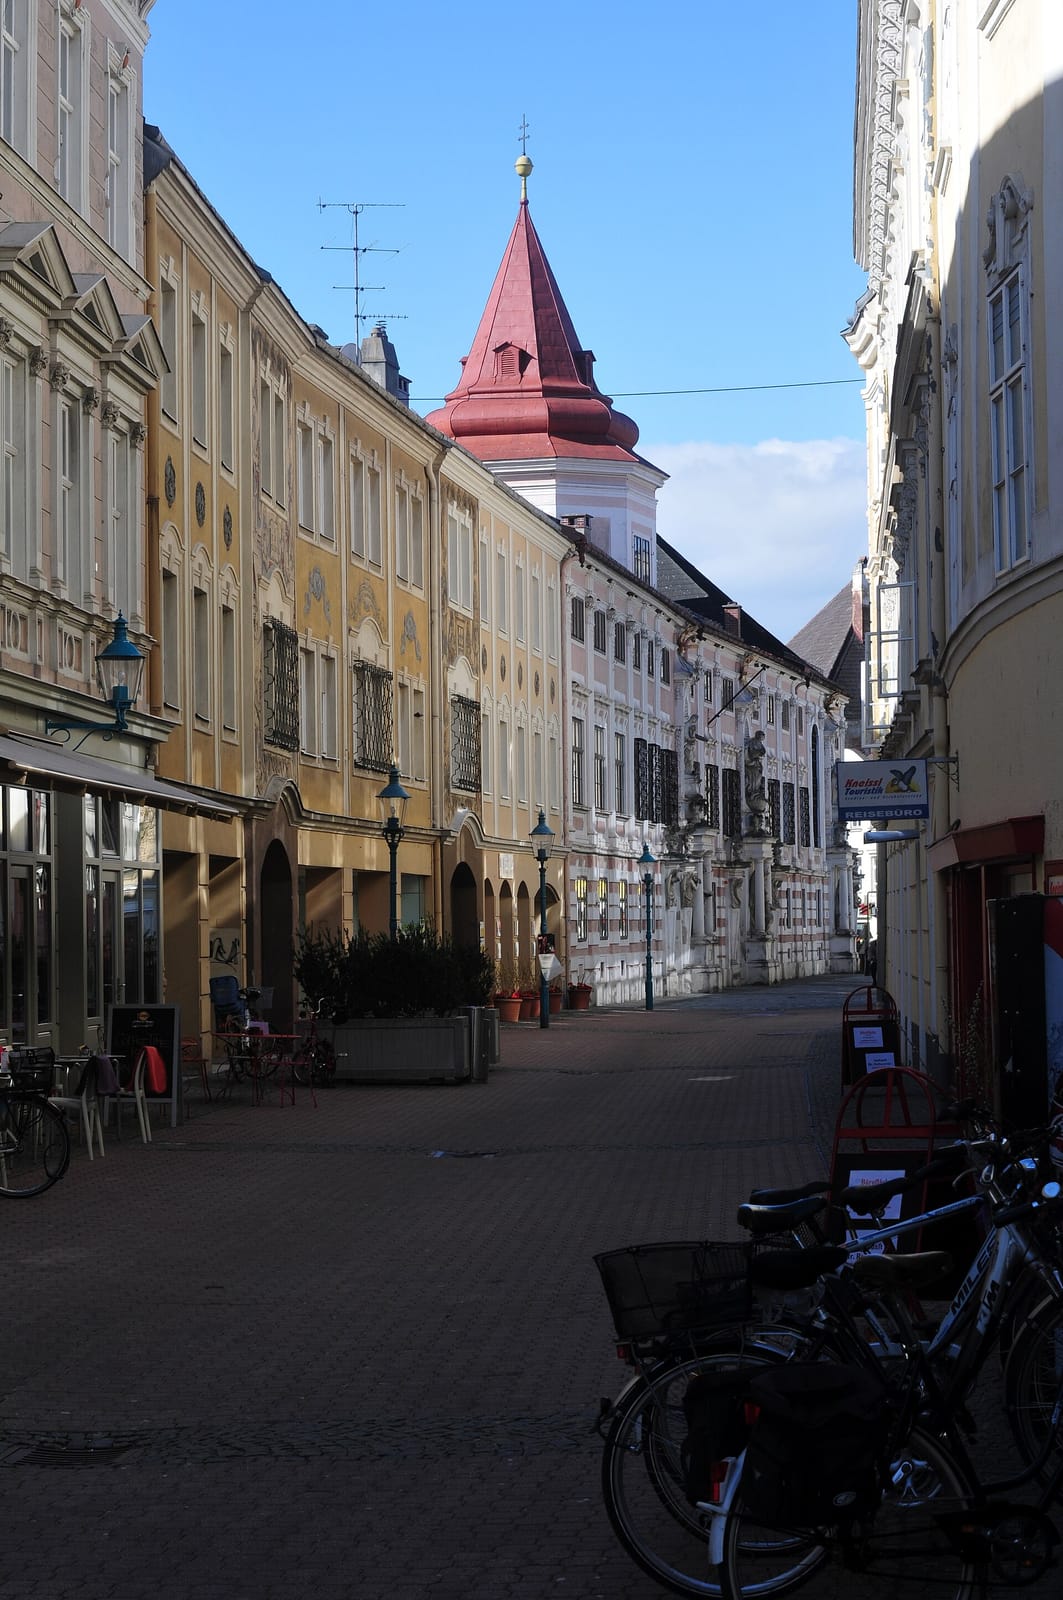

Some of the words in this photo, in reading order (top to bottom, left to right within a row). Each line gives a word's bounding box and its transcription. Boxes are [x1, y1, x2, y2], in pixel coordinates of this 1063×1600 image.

[844, 778, 883, 787] Kneissl
[844, 786, 884, 795] Touristik
[845, 809, 922, 818] REISEBÜRO
